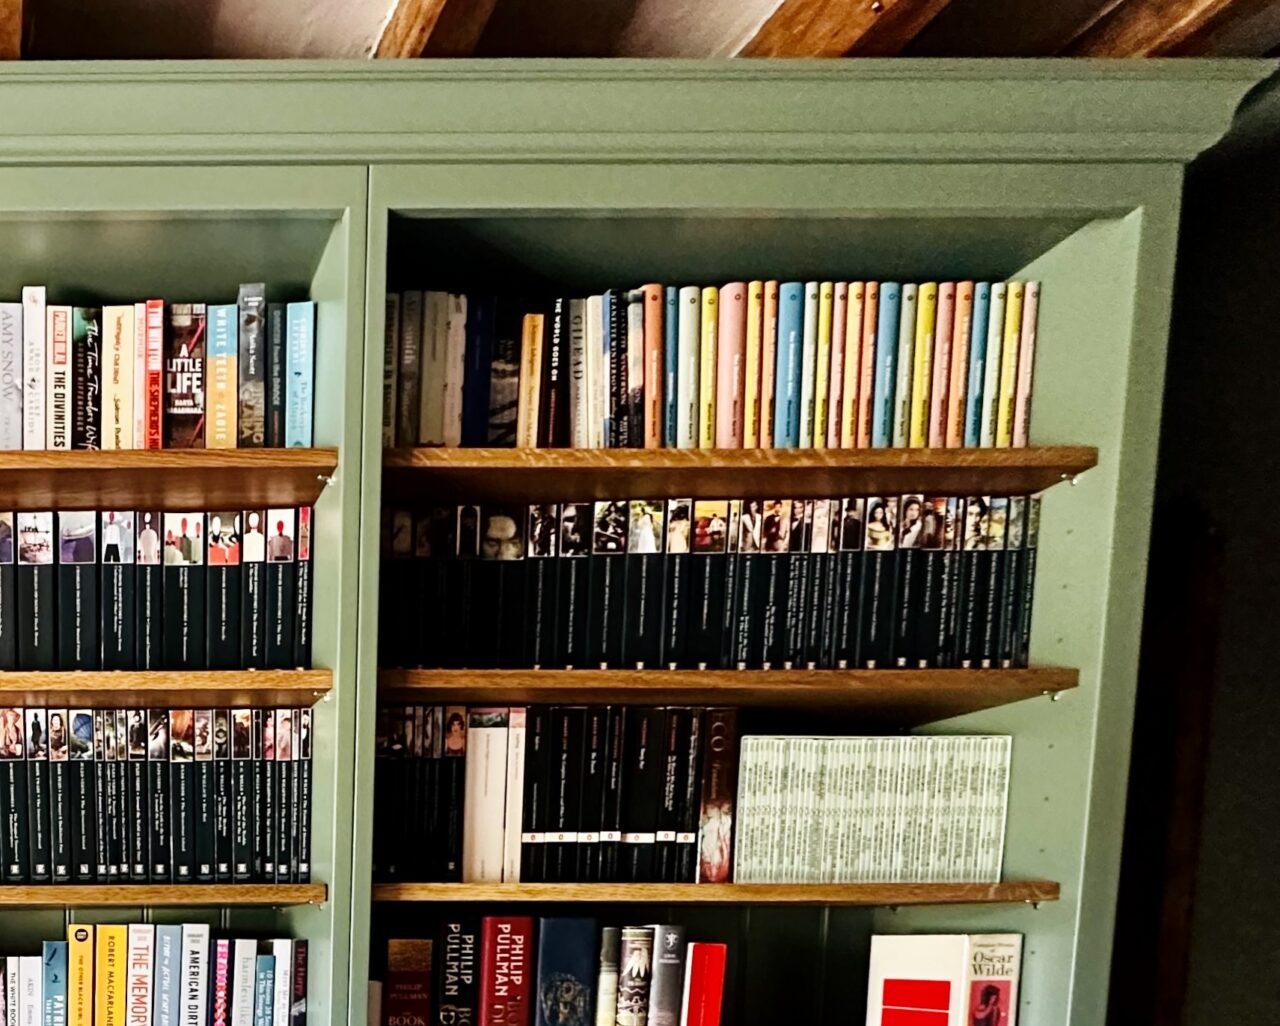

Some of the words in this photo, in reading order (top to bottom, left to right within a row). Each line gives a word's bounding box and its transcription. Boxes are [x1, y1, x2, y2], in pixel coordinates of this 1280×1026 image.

[0, 311, 13, 345] AMY
[553, 316, 561, 344] WORLD
[551, 346, 560, 367] GOES
[571, 315, 584, 381] GILEAD
[1, 348, 14, 401] SNOW
[53, 371, 65, 391] THE
[551, 370, 558, 381] ON
[53, 393, 66, 447] DIVINITIES
[107, 935, 115, 968] ROBERT
[132, 945, 149, 970] THE
[445, 924, 460, 995] PULLMAN
[460, 935, 474, 984] PHILIP
[495, 924, 510, 996] PULLMAN
[509, 935, 524, 985] PHILIP
[972, 951, 1014, 964] Oscar
[188, 950, 200, 1002] AMERICAN
[971, 963, 1014, 977] Wilde
[187, 1005, 198, 1026] DIRT
